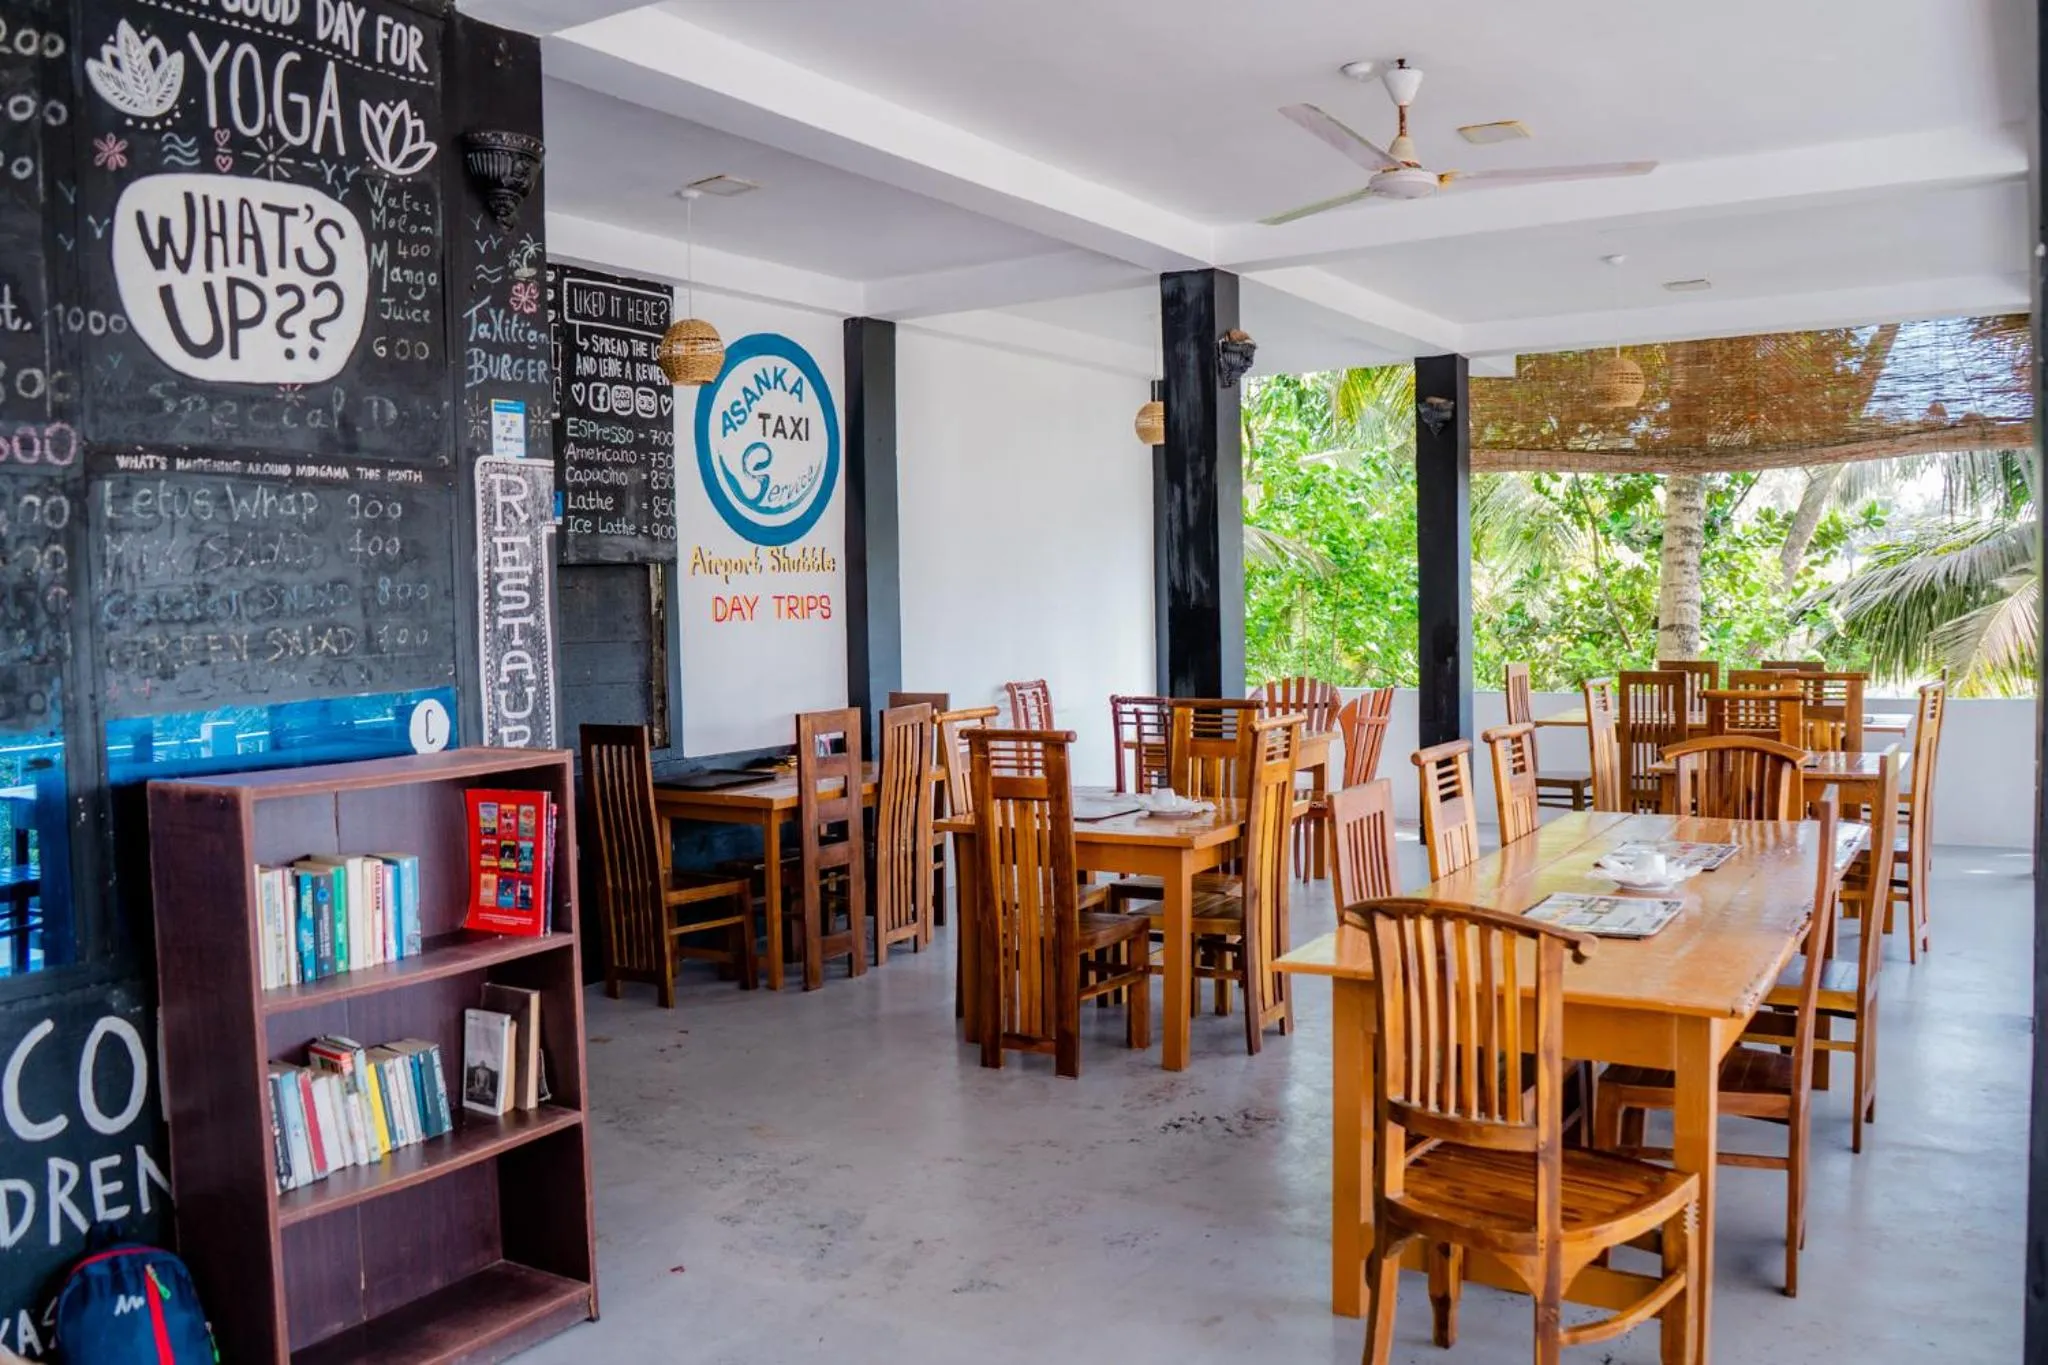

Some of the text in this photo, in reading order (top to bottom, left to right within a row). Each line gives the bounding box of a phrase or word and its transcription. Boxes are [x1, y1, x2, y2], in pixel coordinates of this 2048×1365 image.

[316, 0, 366, 57] DAY
[376, 14, 429, 73] FOR
[188, 31, 345, 156] YOGA
[136, 191, 346, 277] WHAT'S
[397, 239, 431, 259] 400
[370, 239, 438, 300] Mango
[159, 276, 344, 360] UP??
[381, 298, 432, 323] Juice
[611, 295, 621, 319] IT
[628, 297, 668, 326] HERE?
[373, 336, 430, 360] 600
[591, 334, 628, 358] SPREAD
[631, 339, 648, 357] THE
[465, 347, 549, 389] BURGER
[576, 353, 597, 377] AND
[599, 357, 623, 378] LEAVE
[625, 361, 632, 380] A
[721, 366, 804, 438] ASANKA
[650, 430, 674, 447] 700
[757, 412, 809, 442] TAXI
[115, 454, 169, 470] WHAT'S
[247, 462, 292, 477] AROUND
[387, 469, 423, 483] MONTH
[564, 442, 637, 464] Americano
[649, 452, 674, 469] 750
[651, 470, 675, 490] 850
[347, 493, 402, 519] 900
[567, 515, 592, 534] Ice
[652, 523, 677, 540] 900
[690, 545, 763, 584] Airport
[378, 576, 429, 605] 800
[712, 594, 833, 623] DAY TRIPS
